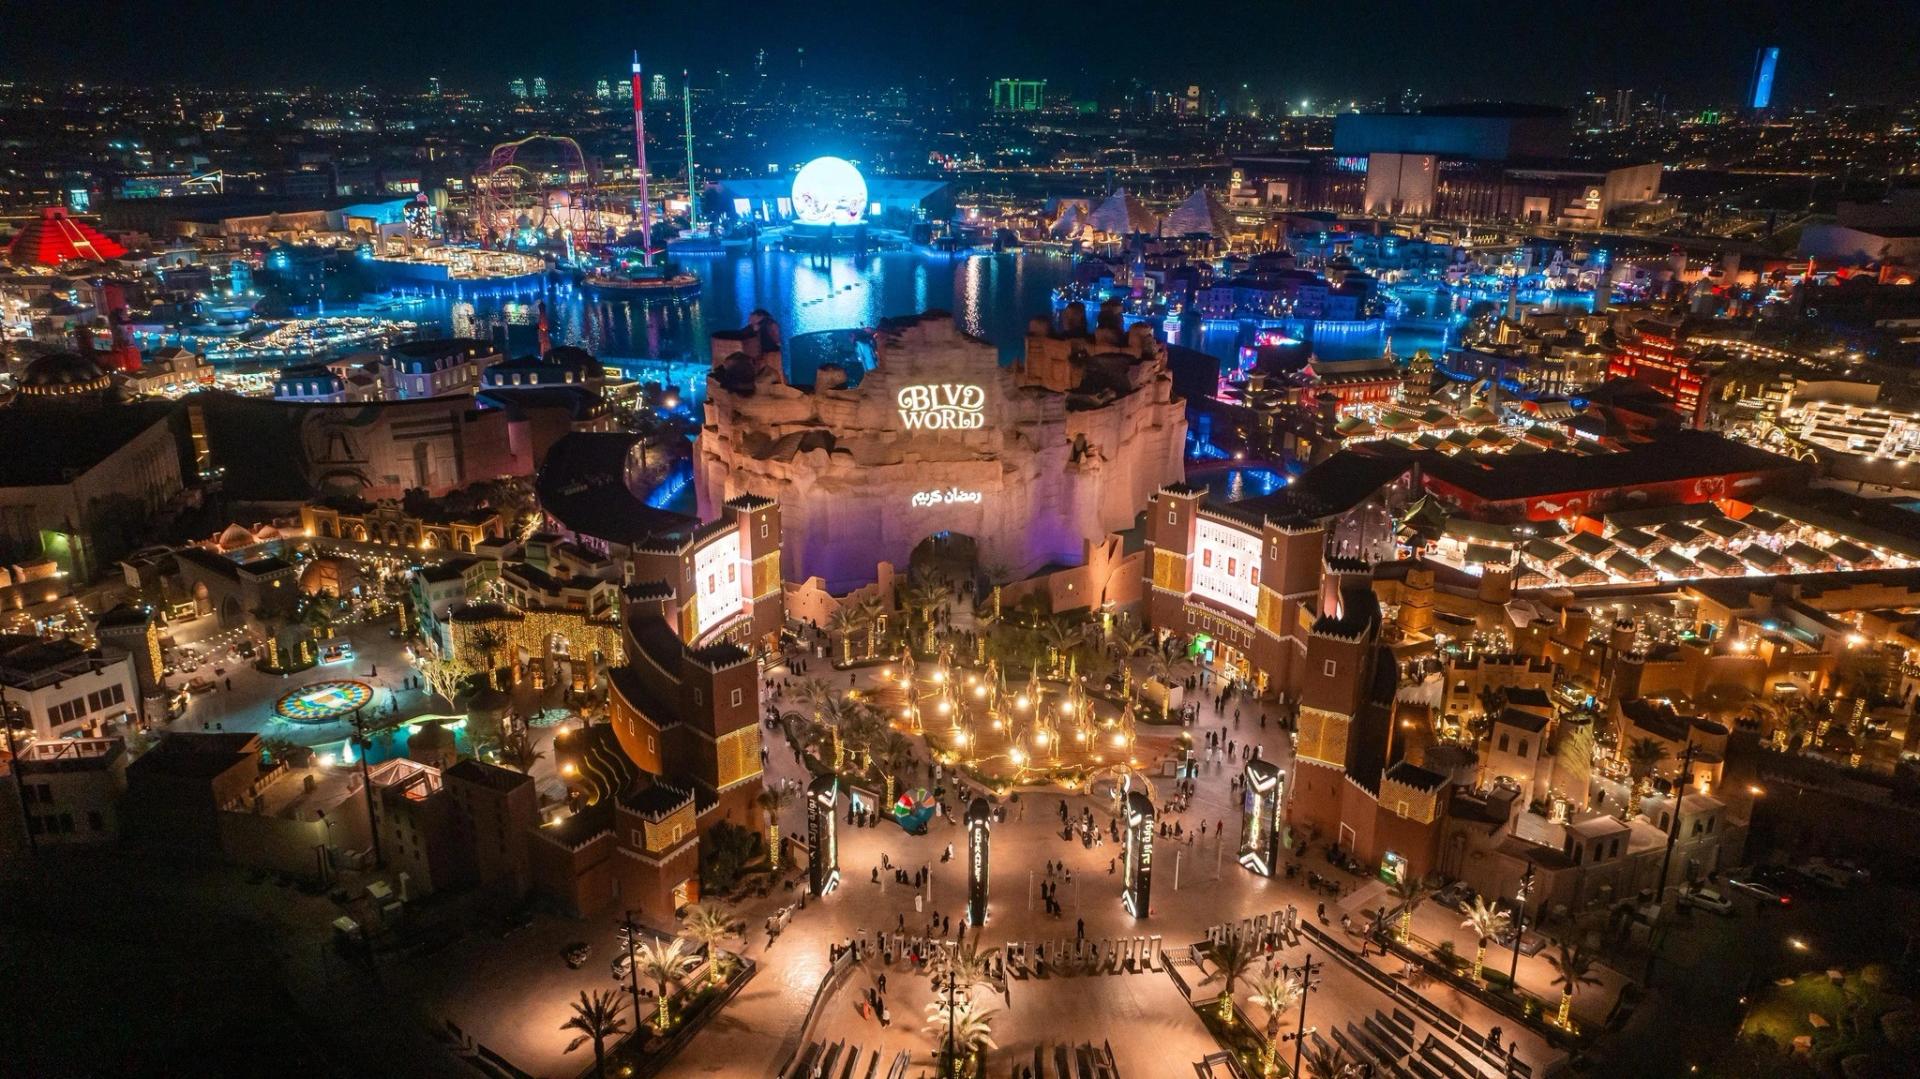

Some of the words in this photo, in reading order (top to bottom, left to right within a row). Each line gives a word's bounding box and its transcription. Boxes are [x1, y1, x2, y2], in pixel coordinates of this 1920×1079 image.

[898, 384, 985, 411] BLVD
[898, 409, 985, 429] WORLD
[911, 490, 943, 507] كريم
[944, 487, 982, 503] رمضان
